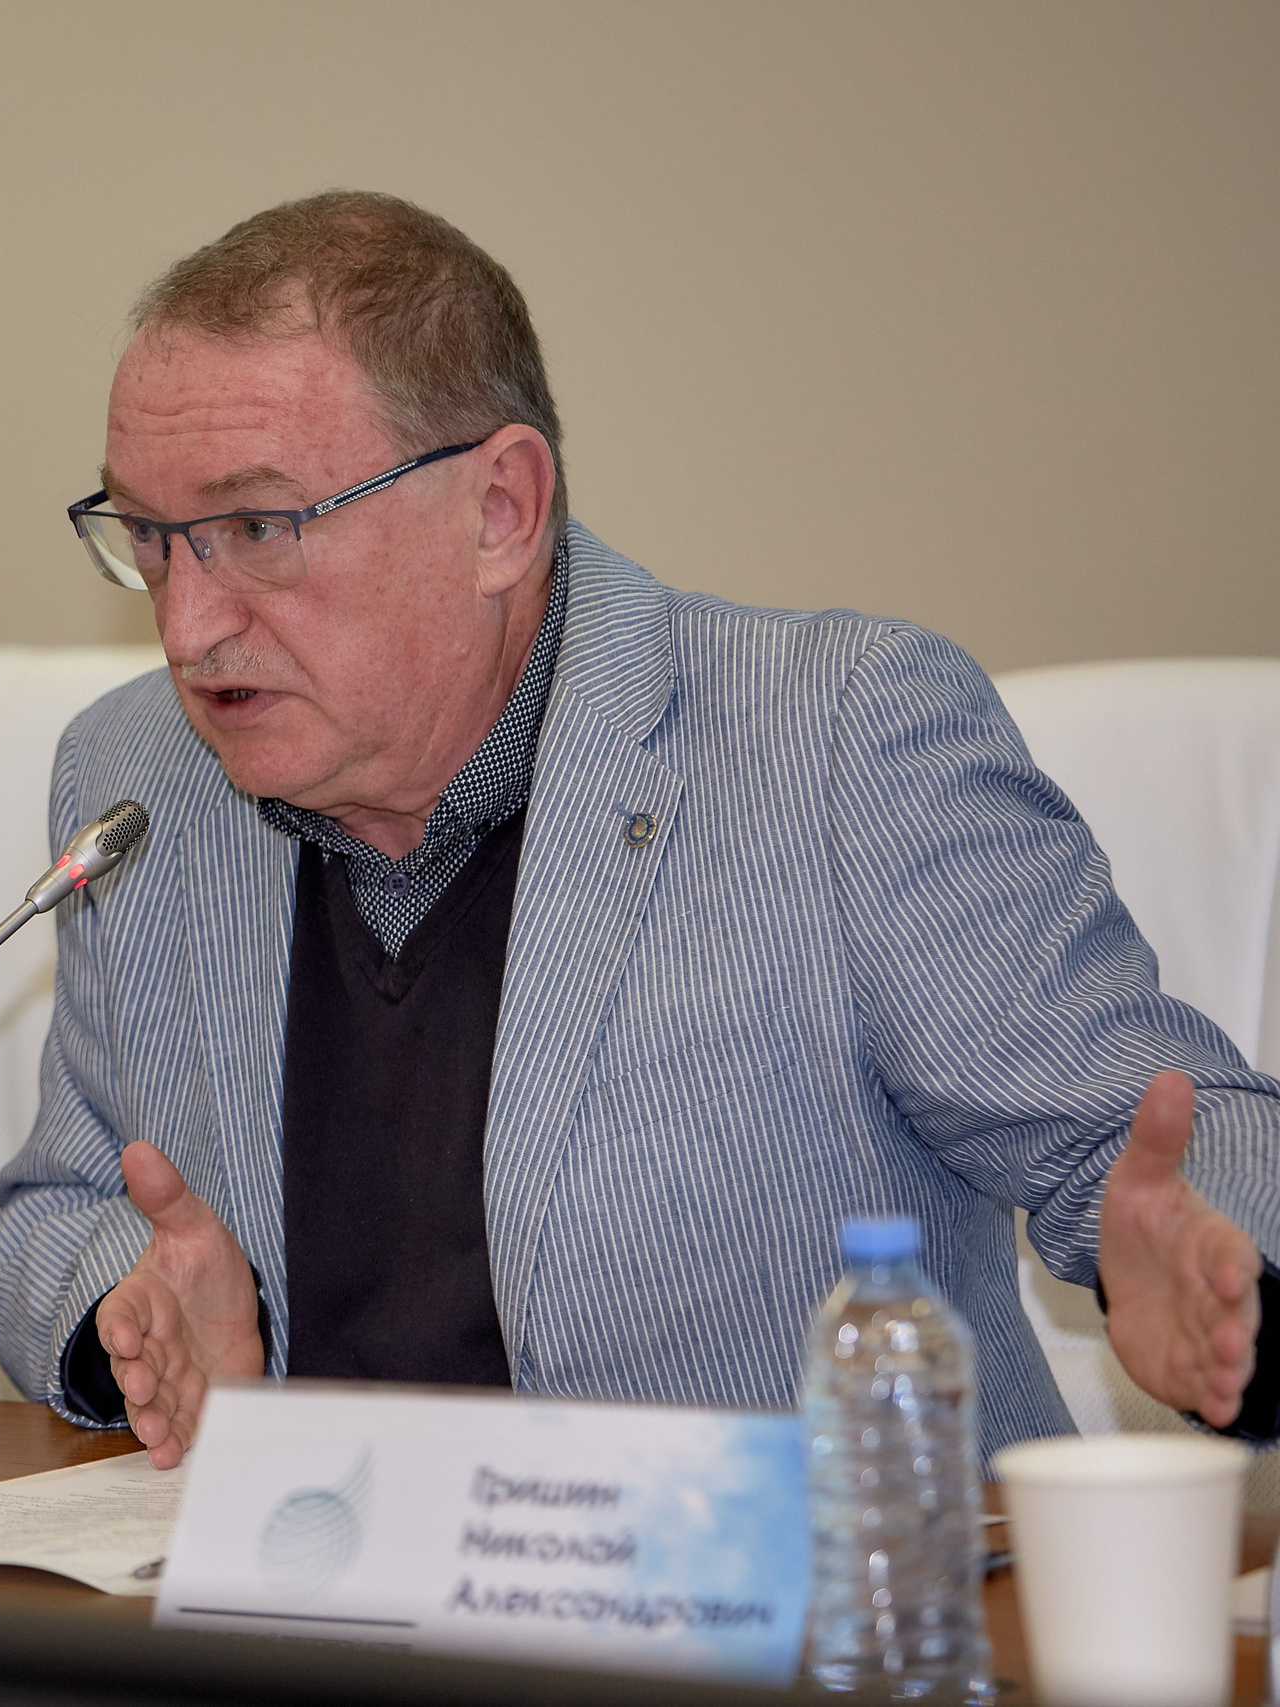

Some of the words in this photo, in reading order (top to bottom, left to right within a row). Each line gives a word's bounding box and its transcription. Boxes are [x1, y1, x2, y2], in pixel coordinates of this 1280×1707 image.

[474, 1465, 620, 1509] Гришин
[461, 1521, 636, 1564] Николай
[450, 1577, 775, 1628] Александрович
